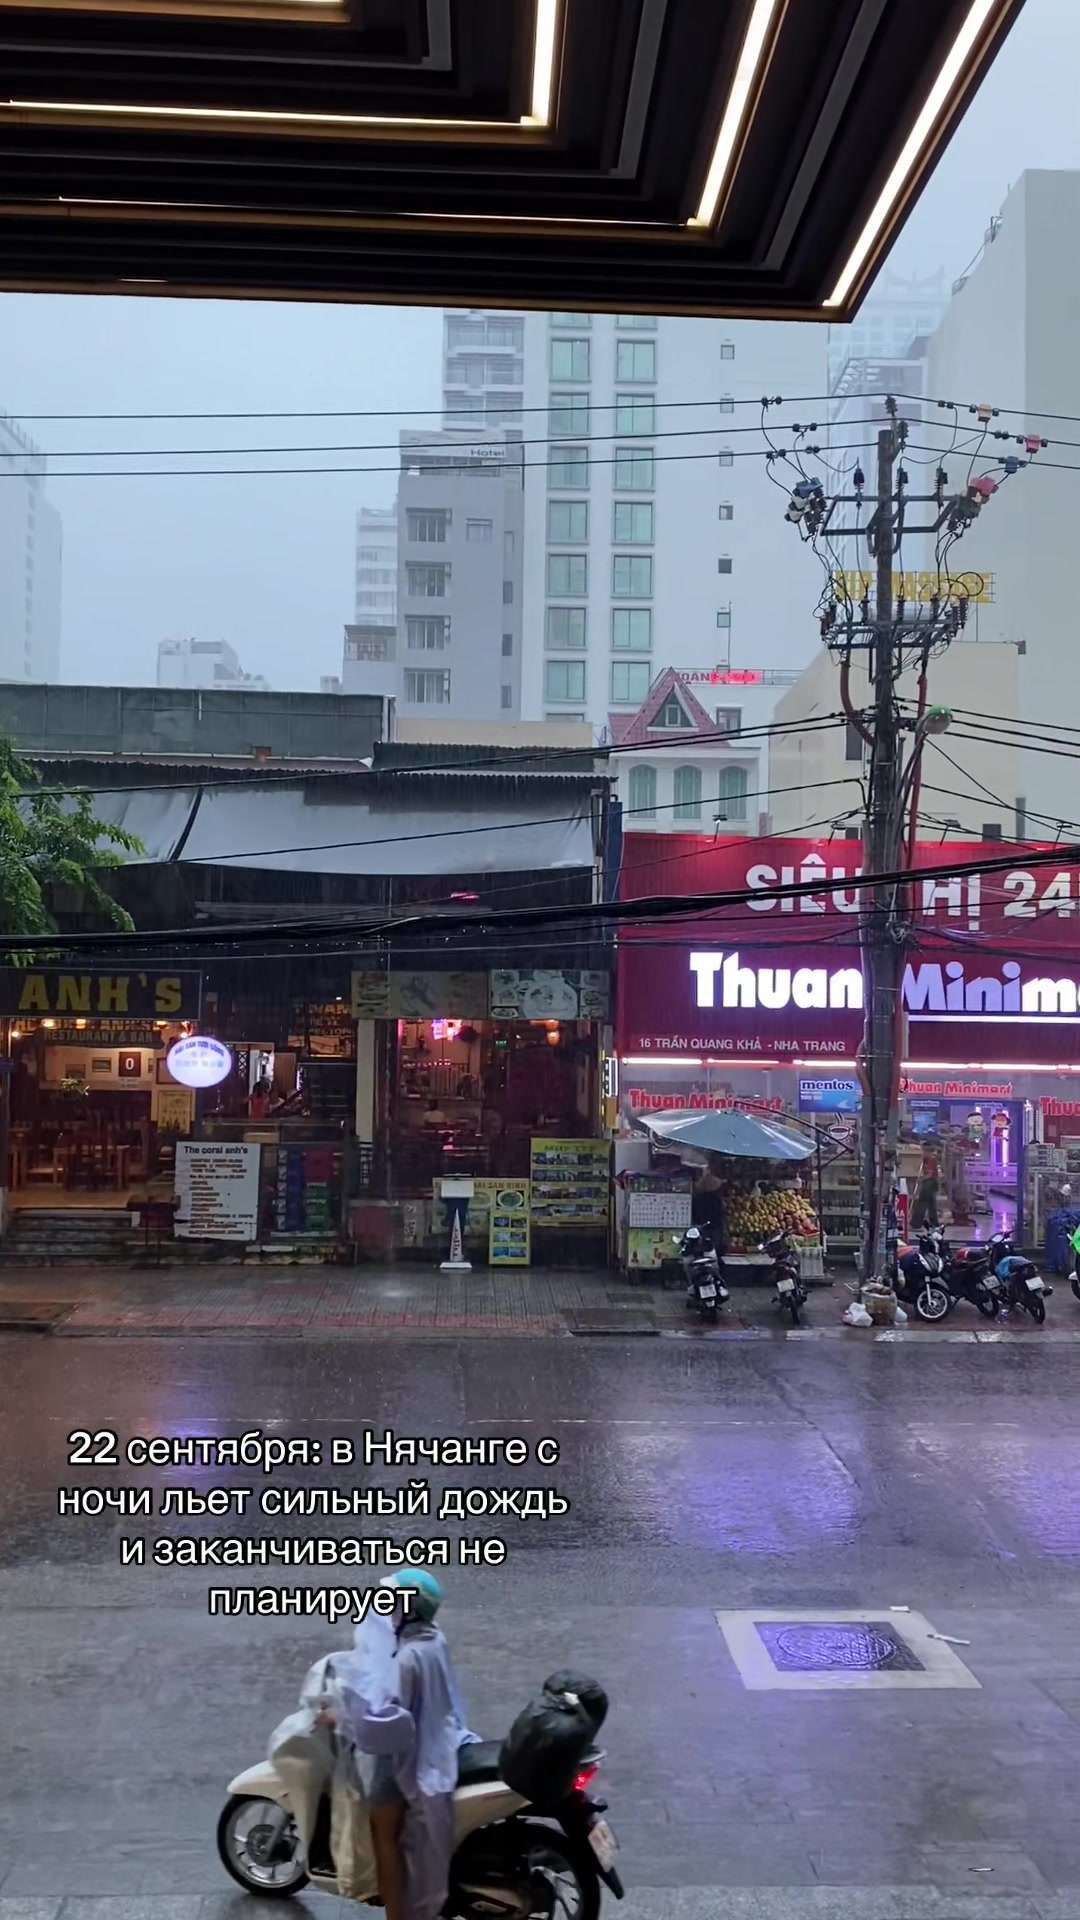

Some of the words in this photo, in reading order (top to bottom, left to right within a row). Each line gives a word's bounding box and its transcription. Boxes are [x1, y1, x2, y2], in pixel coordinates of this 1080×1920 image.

[471, 449, 505, 457] Hotel
[922, 873, 981, 931] HỊ
[1003, 871, 1080, 918] 24
[690, 952, 863, 1009] Thuan
[902, 961, 1080, 1012] Minim
[18, 972, 182, 1013] ANH'S
[639, 1038, 651, 1048] 16
[690, 1038, 733, 1050] QUANG
[803, 1041, 846, 1052] TRANG
[801, 1080, 854, 1091] mentos
[943, 1080, 1012, 1097] Minimart
[629, 1088, 685, 1110] Thuan
[184, 1144, 200, 1154] The
